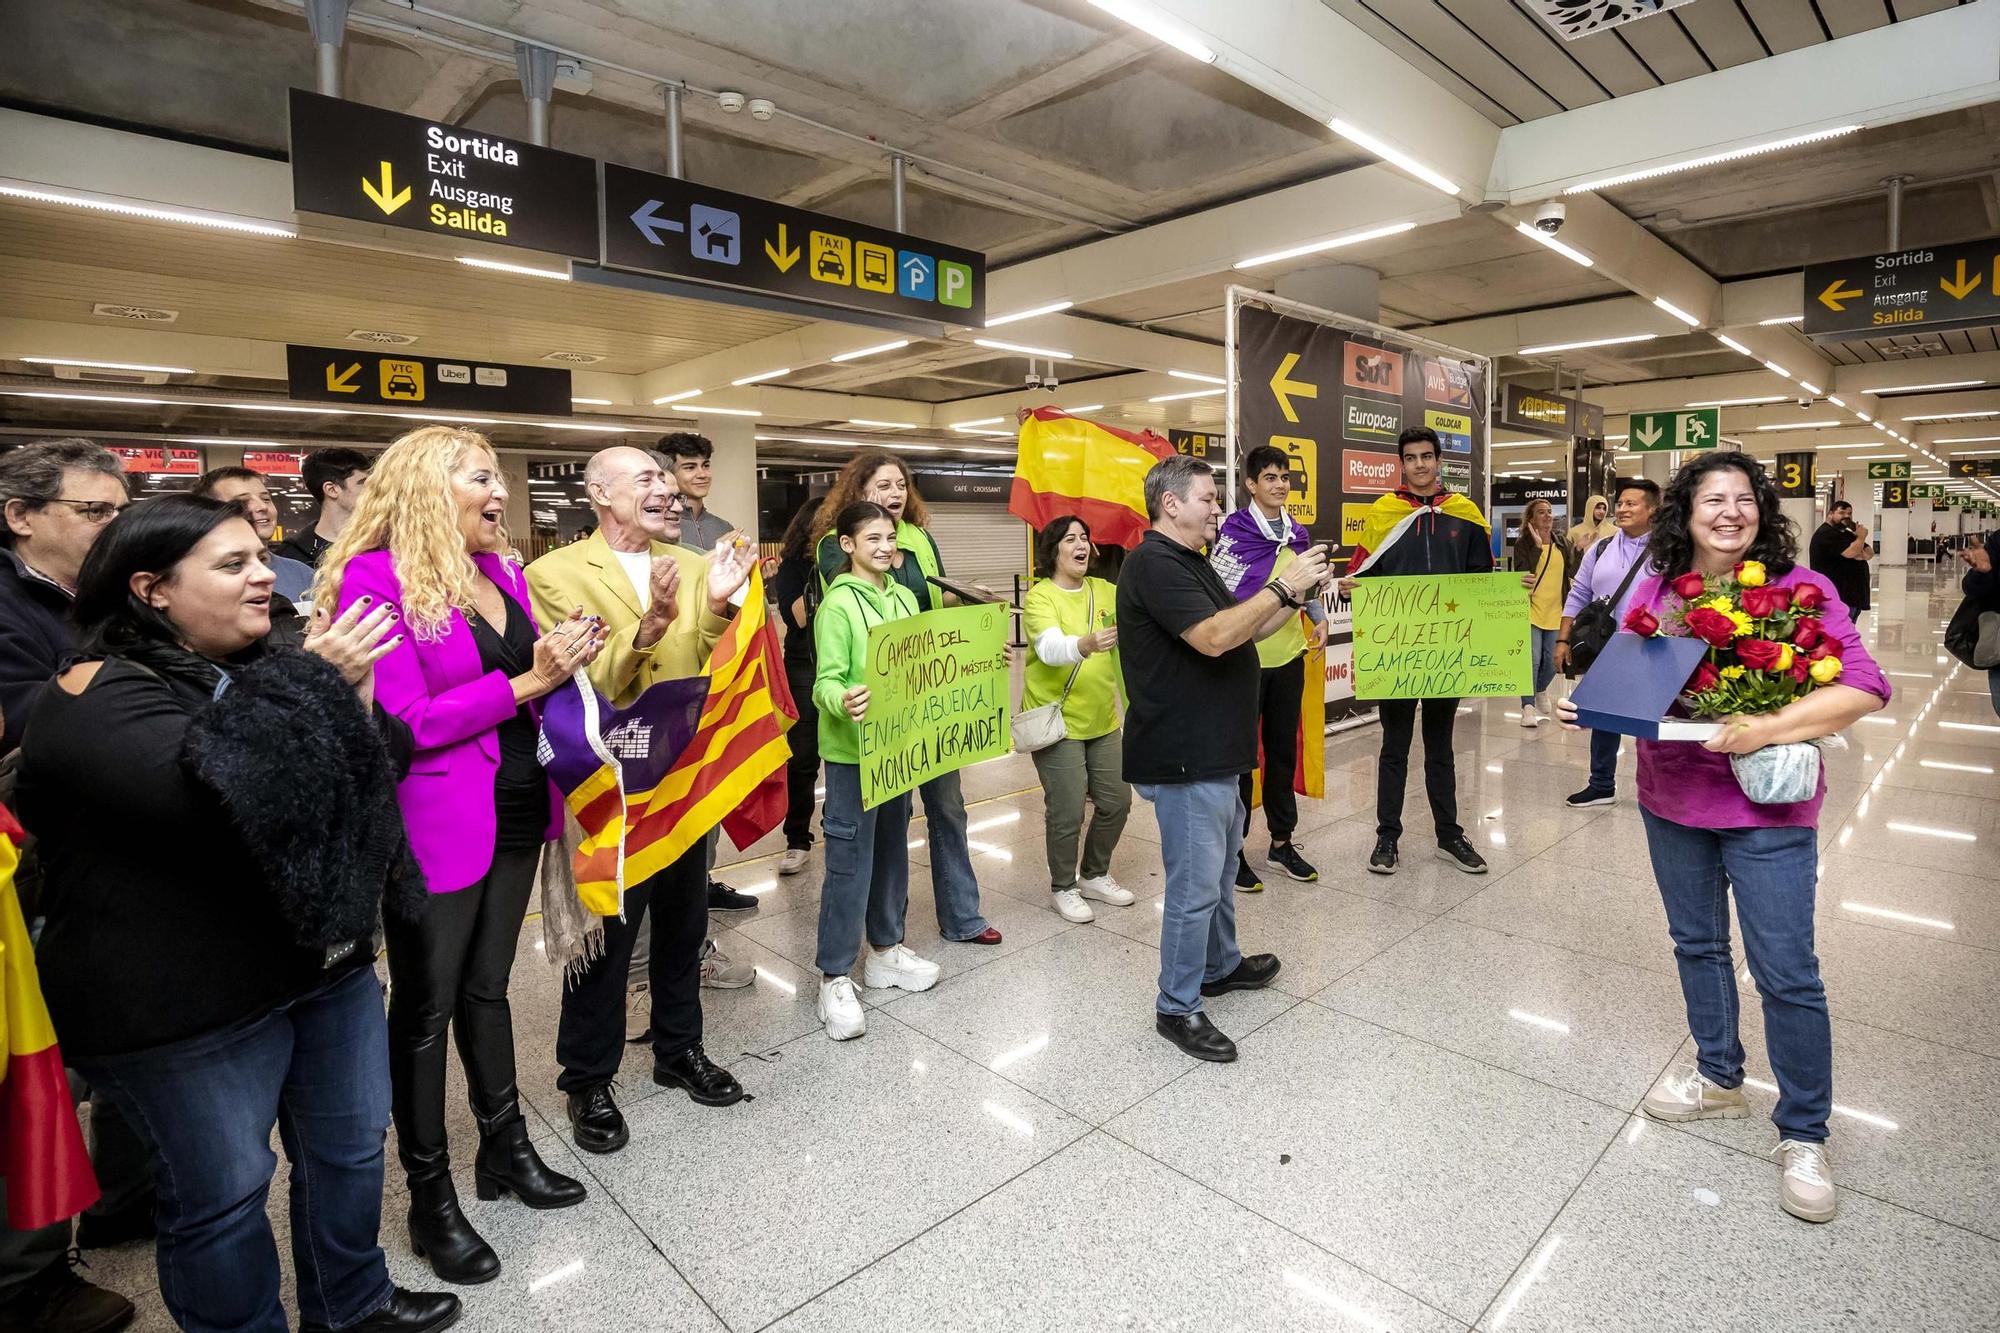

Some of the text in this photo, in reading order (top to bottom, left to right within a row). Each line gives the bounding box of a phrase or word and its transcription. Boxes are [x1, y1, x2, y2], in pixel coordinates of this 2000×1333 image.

[427, 126, 519, 166] Sortida
[427, 154, 466, 179] Exit
[429, 179, 513, 215] Ausgang
[429, 203, 508, 237] Salida
[818, 235, 844, 250] TAXI
[1875, 250, 1934, 270] Sortida
[911, 268, 925, 291] P
[946, 267, 965, 299] P
[1874, 274, 1897, 288] Exit
[1873, 290, 1928, 307] Ausgang
[1873, 308, 1924, 325] Salida
[391, 364, 413, 374] VTC
[441, 369, 466, 379] Uber
[1427, 375, 1446, 393] AVIS
[1348, 406, 1398, 432] Europcar
[1435, 416, 1462, 430] GOLDCAR
[1782, 463, 1801, 488] 3
[1525, 490, 1559, 499] OFICINA
[1889, 487, 1902, 503] 3
[1288, 504, 1314, 517] RENTAL
[1345, 515, 1365, 532] Hert
[1359, 580, 1440, 617] MÓNICA
[1371, 618, 1474, 650] CALZETTA
[876, 628, 970, 676] CAMPEONA DEL
[1358, 647, 1464, 672] CAMPEONA
[1469, 654, 1498, 667] DEL
[906, 654, 957, 701] MUNDO
[961, 659, 994, 678] MÁSTER
[1390, 671, 1517, 696] MUNDO MÁSTER 50
[870, 707, 1004, 801] MÓNICA ¡GRANDE!
